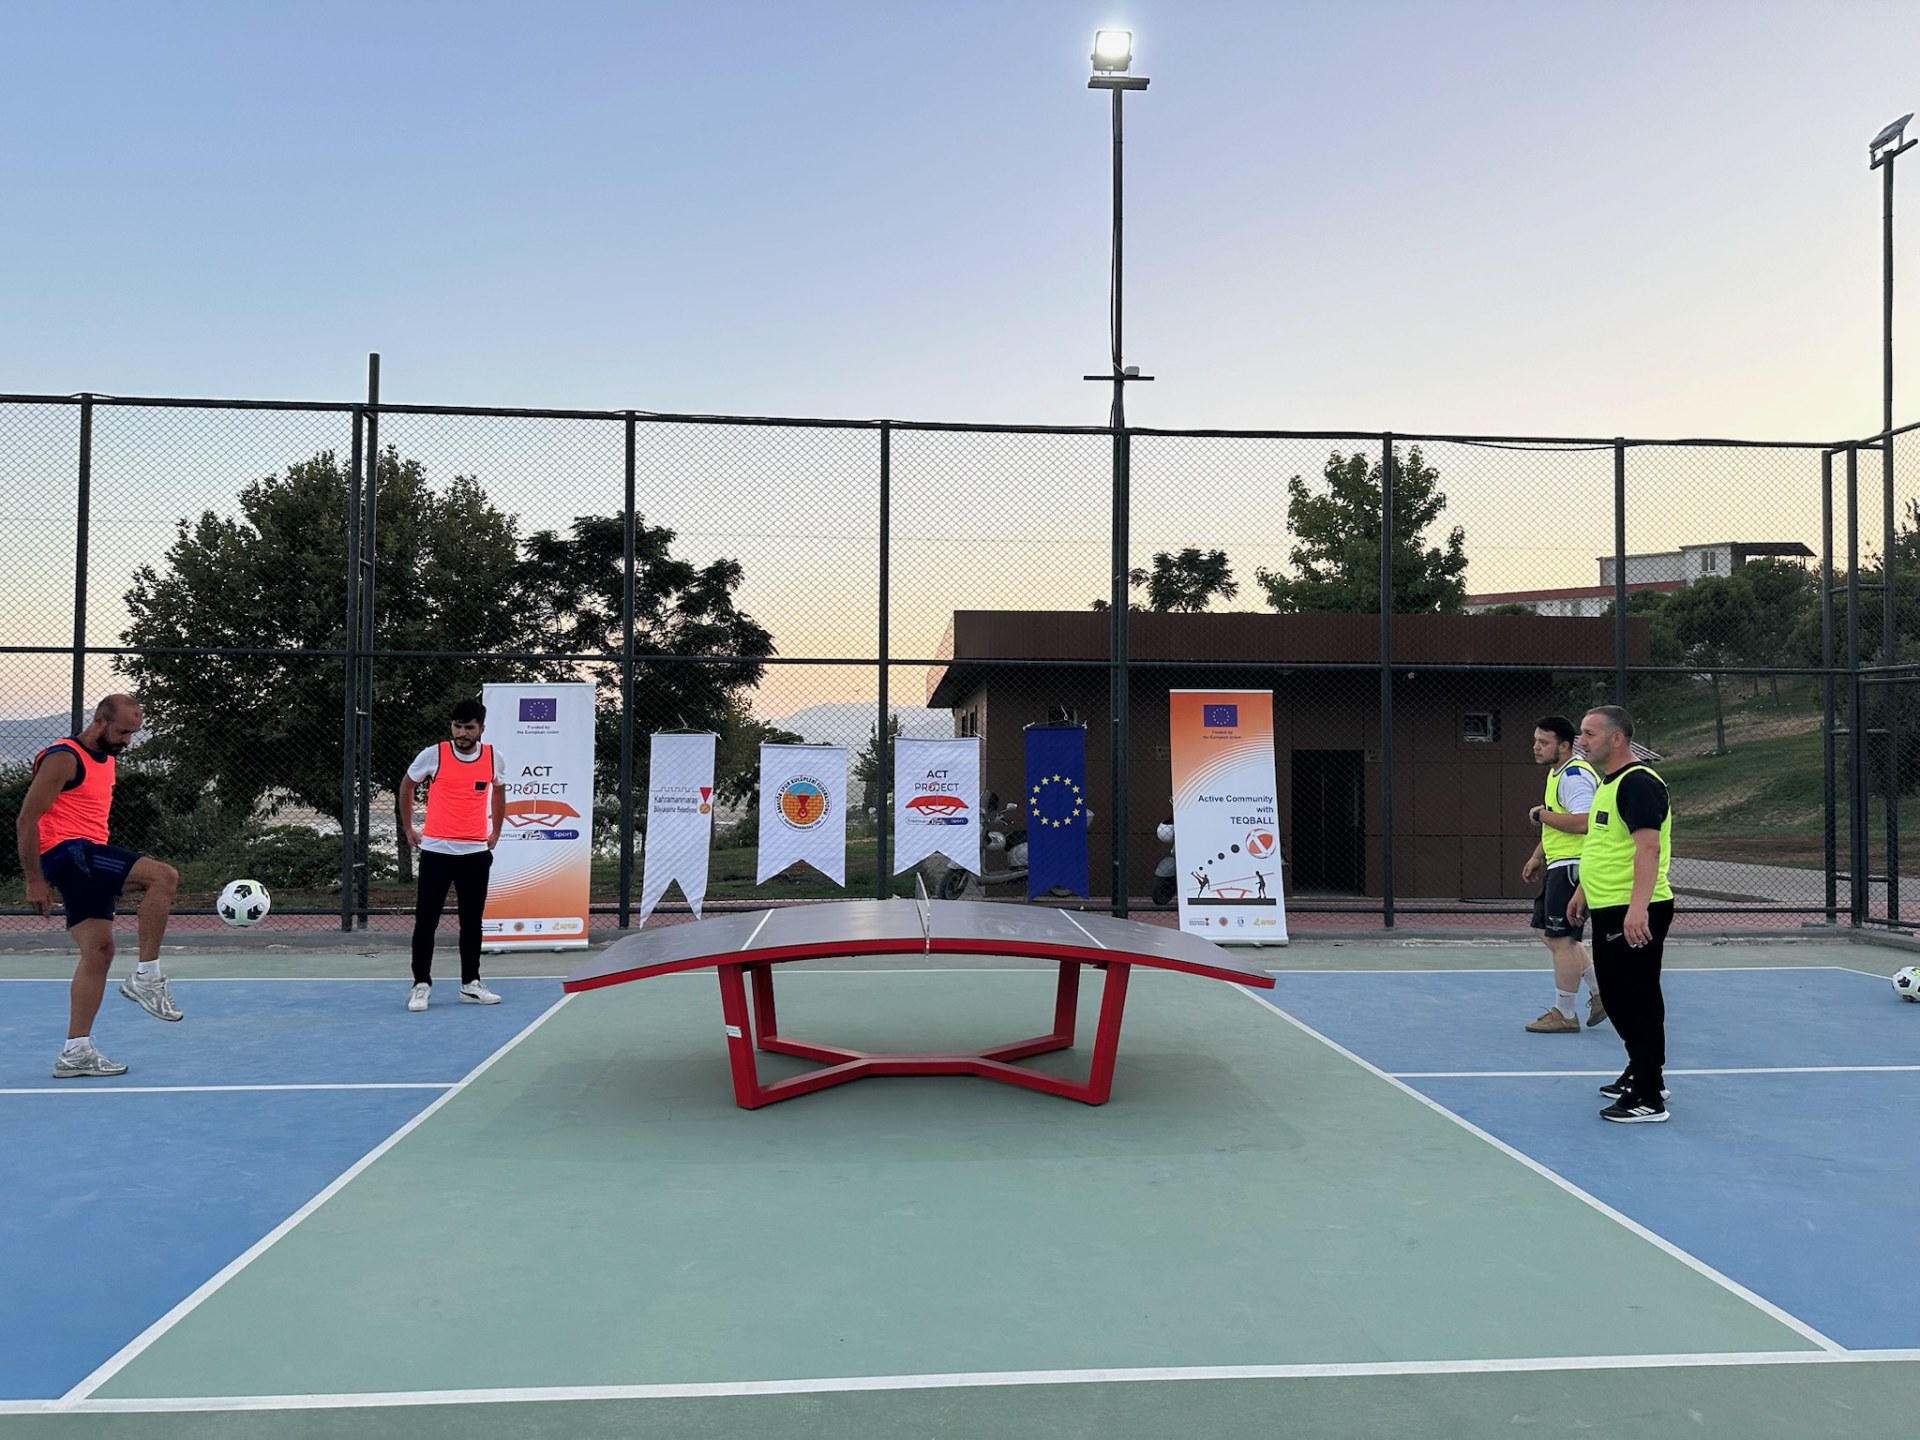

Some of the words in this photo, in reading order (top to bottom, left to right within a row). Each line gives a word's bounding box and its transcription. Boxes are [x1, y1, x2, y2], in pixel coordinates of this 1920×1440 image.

[521, 766, 553, 777] ACT
[926, 769, 949, 779] ACT
[505, 783, 568, 795] PROJECT
[914, 783, 960, 792] PROJECT
[1198, 795, 1224, 803] Active
[1225, 795, 1273, 804] Community
[1230, 816, 1275, 825] TEQBALL
